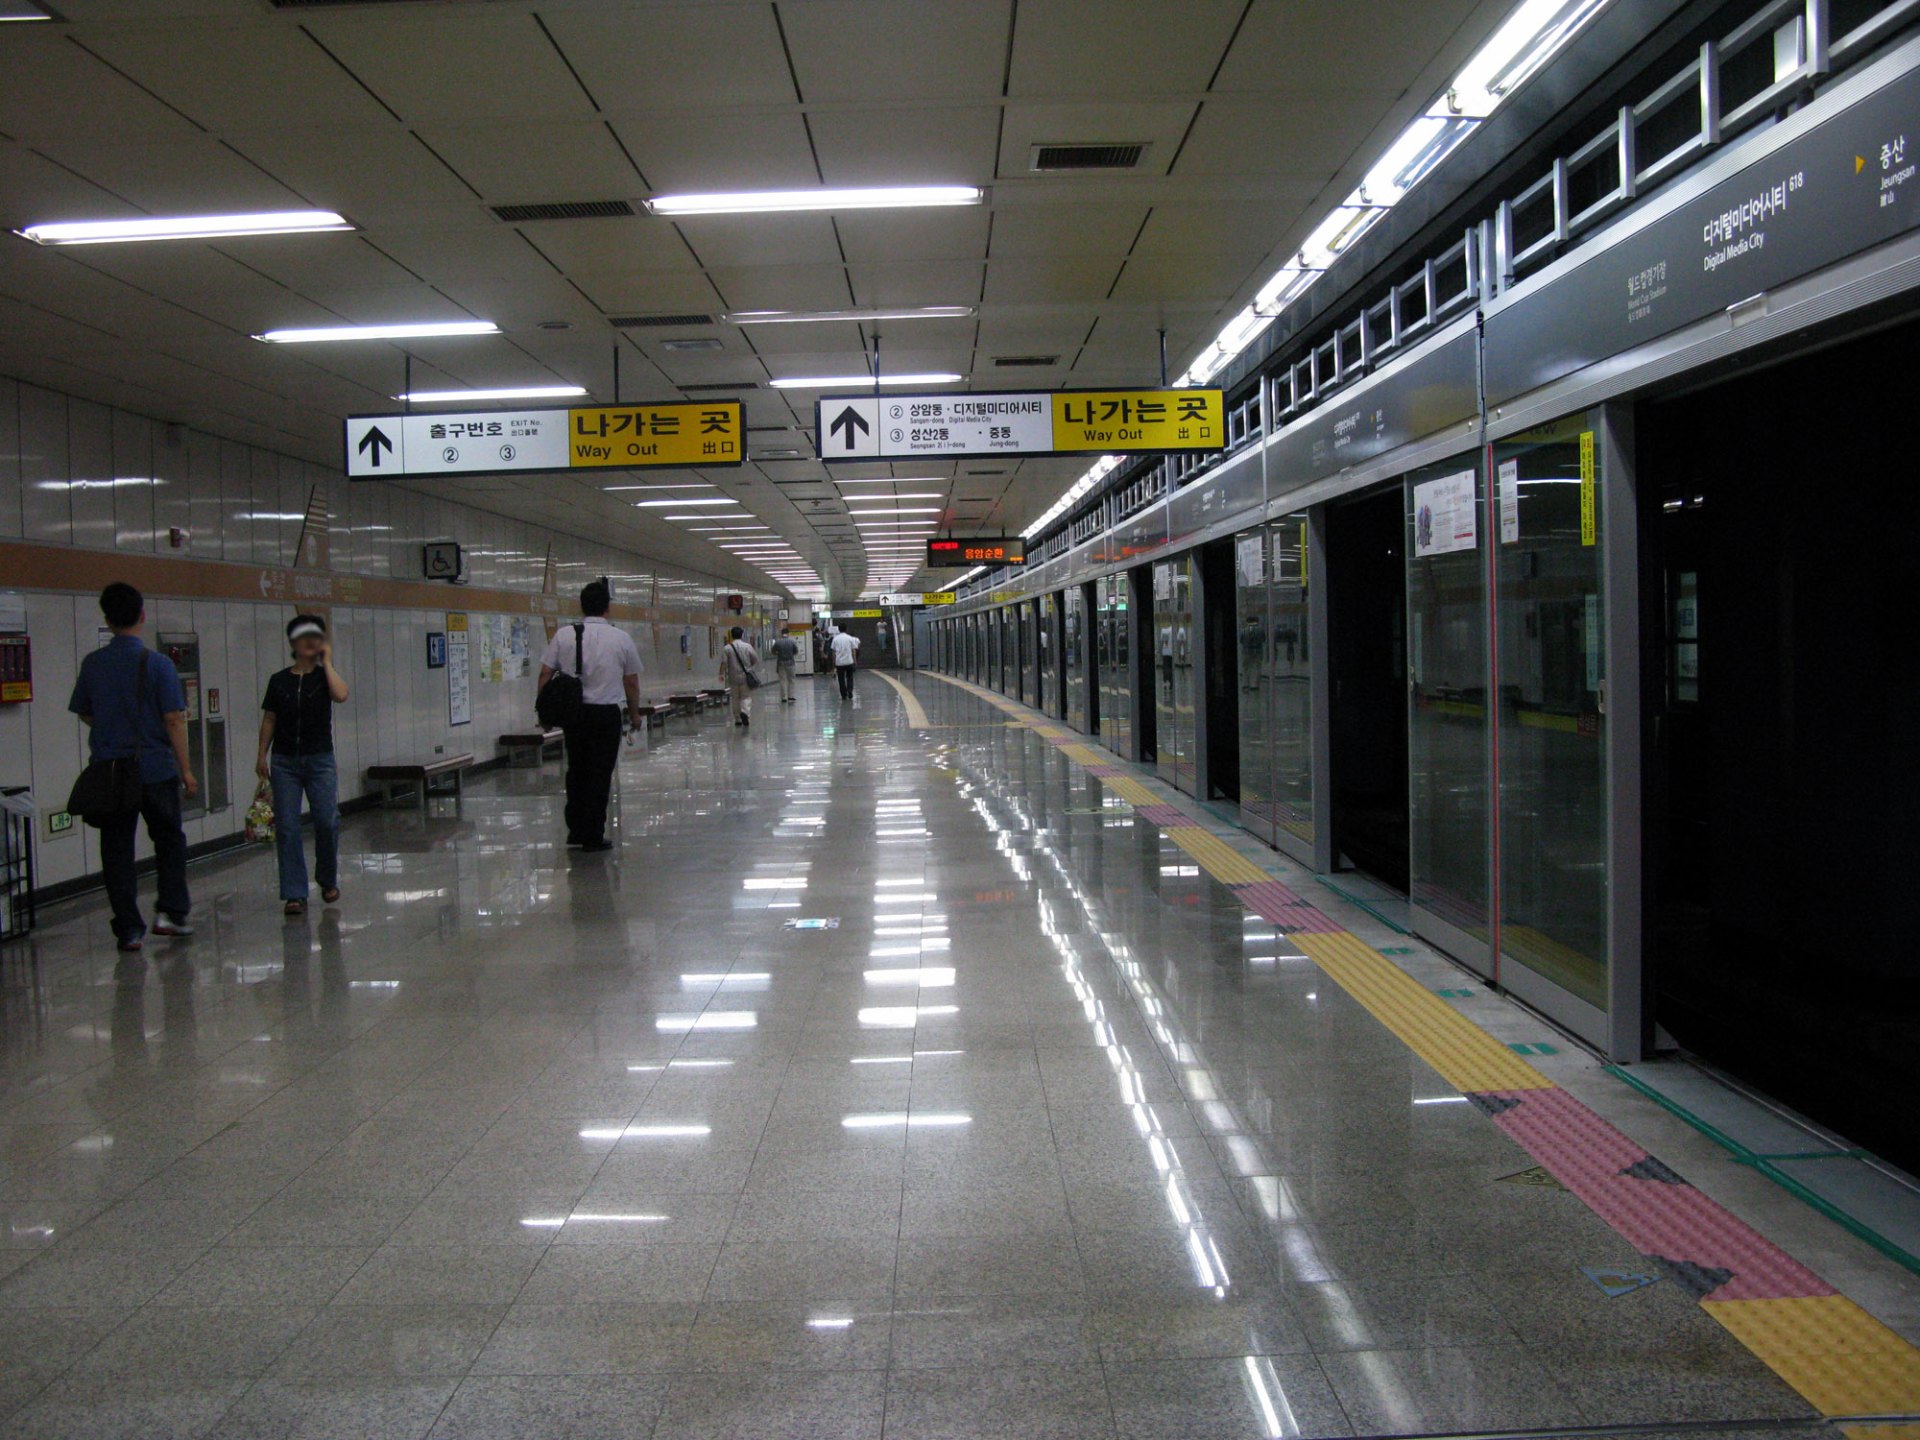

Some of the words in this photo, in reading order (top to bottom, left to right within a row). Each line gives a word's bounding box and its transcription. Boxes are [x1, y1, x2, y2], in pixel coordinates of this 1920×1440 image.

[1880, 134, 1905, 170] 증산
[1880, 165, 1915, 190] Jeungsan
[1703, 181, 1786, 247] 디지털미디어시티
[1789, 171, 1803, 192] 618
[1703, 247, 1726, 271] Digital
[1726, 238, 1748, 260] Media
[1749, 232, 1764, 249] City
[910, 404, 942, 417] 상암동
[954, 401, 1042, 416] 디지털미디어시티
[1064, 400, 1167, 425] 나가는
[1177, 397, 1208, 422] 곳
[577, 412, 680, 438] 나가는
[700, 411, 731, 434] 곳
[949, 416, 966, 424] Digital
[981, 415, 992, 423] City
[430, 422, 503, 439] 출구번호
[910, 428, 950, 442] 성산2동
[989, 426, 1012, 439] 중동
[1084, 429, 1113, 442] Way
[1118, 428, 1143, 440] Out
[1178, 427, 1211, 440] 出口
[576, 445, 612, 460] Way
[627, 443, 659, 456] Out
[702, 441, 735, 455] 出口
